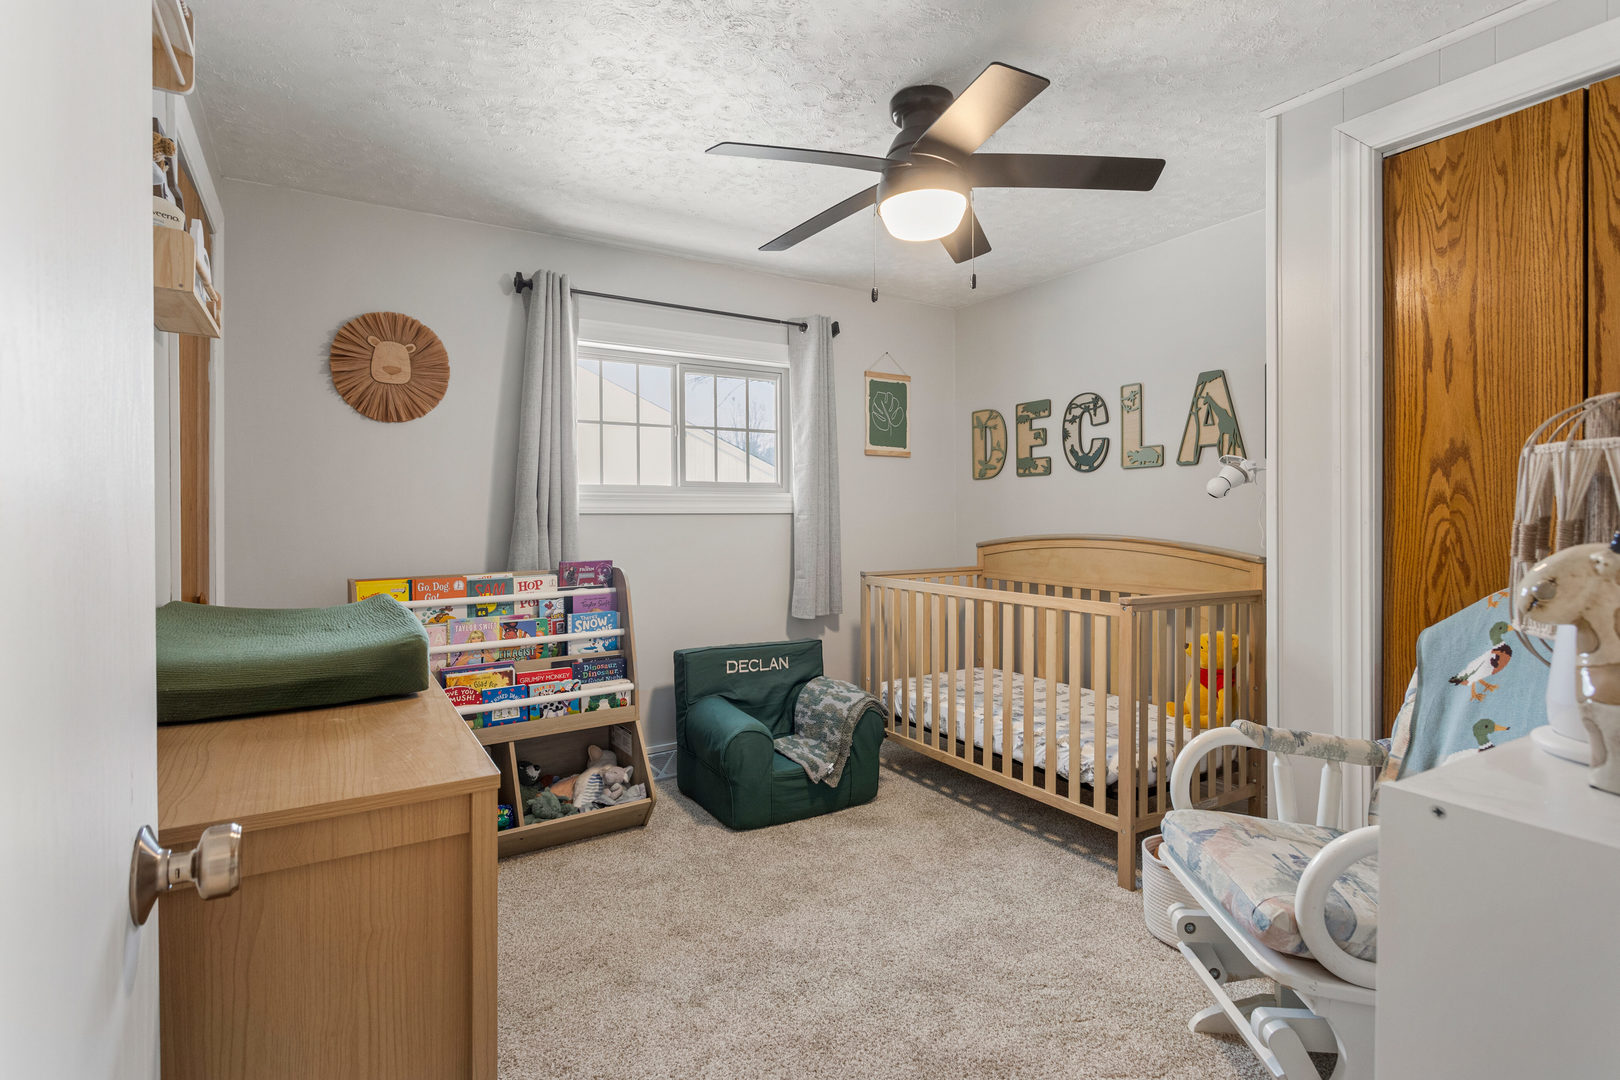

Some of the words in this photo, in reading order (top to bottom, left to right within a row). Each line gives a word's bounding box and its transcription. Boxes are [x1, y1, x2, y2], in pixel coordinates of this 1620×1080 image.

[153, 210, 179, 222] veeno
[972, 369, 1266, 480] DECLA
[475, 582, 506, 596] SAM
[517, 580, 543, 592] HOP
[455, 623, 477, 632] TAYLOR
[479, 622, 498, 630] SWIFT
[574, 616, 607, 633] SNOW
[726, 656, 789, 674] DECLAN
[519, 675, 544, 684] GRUMPY
[545, 672, 570, 681] MONKEY
